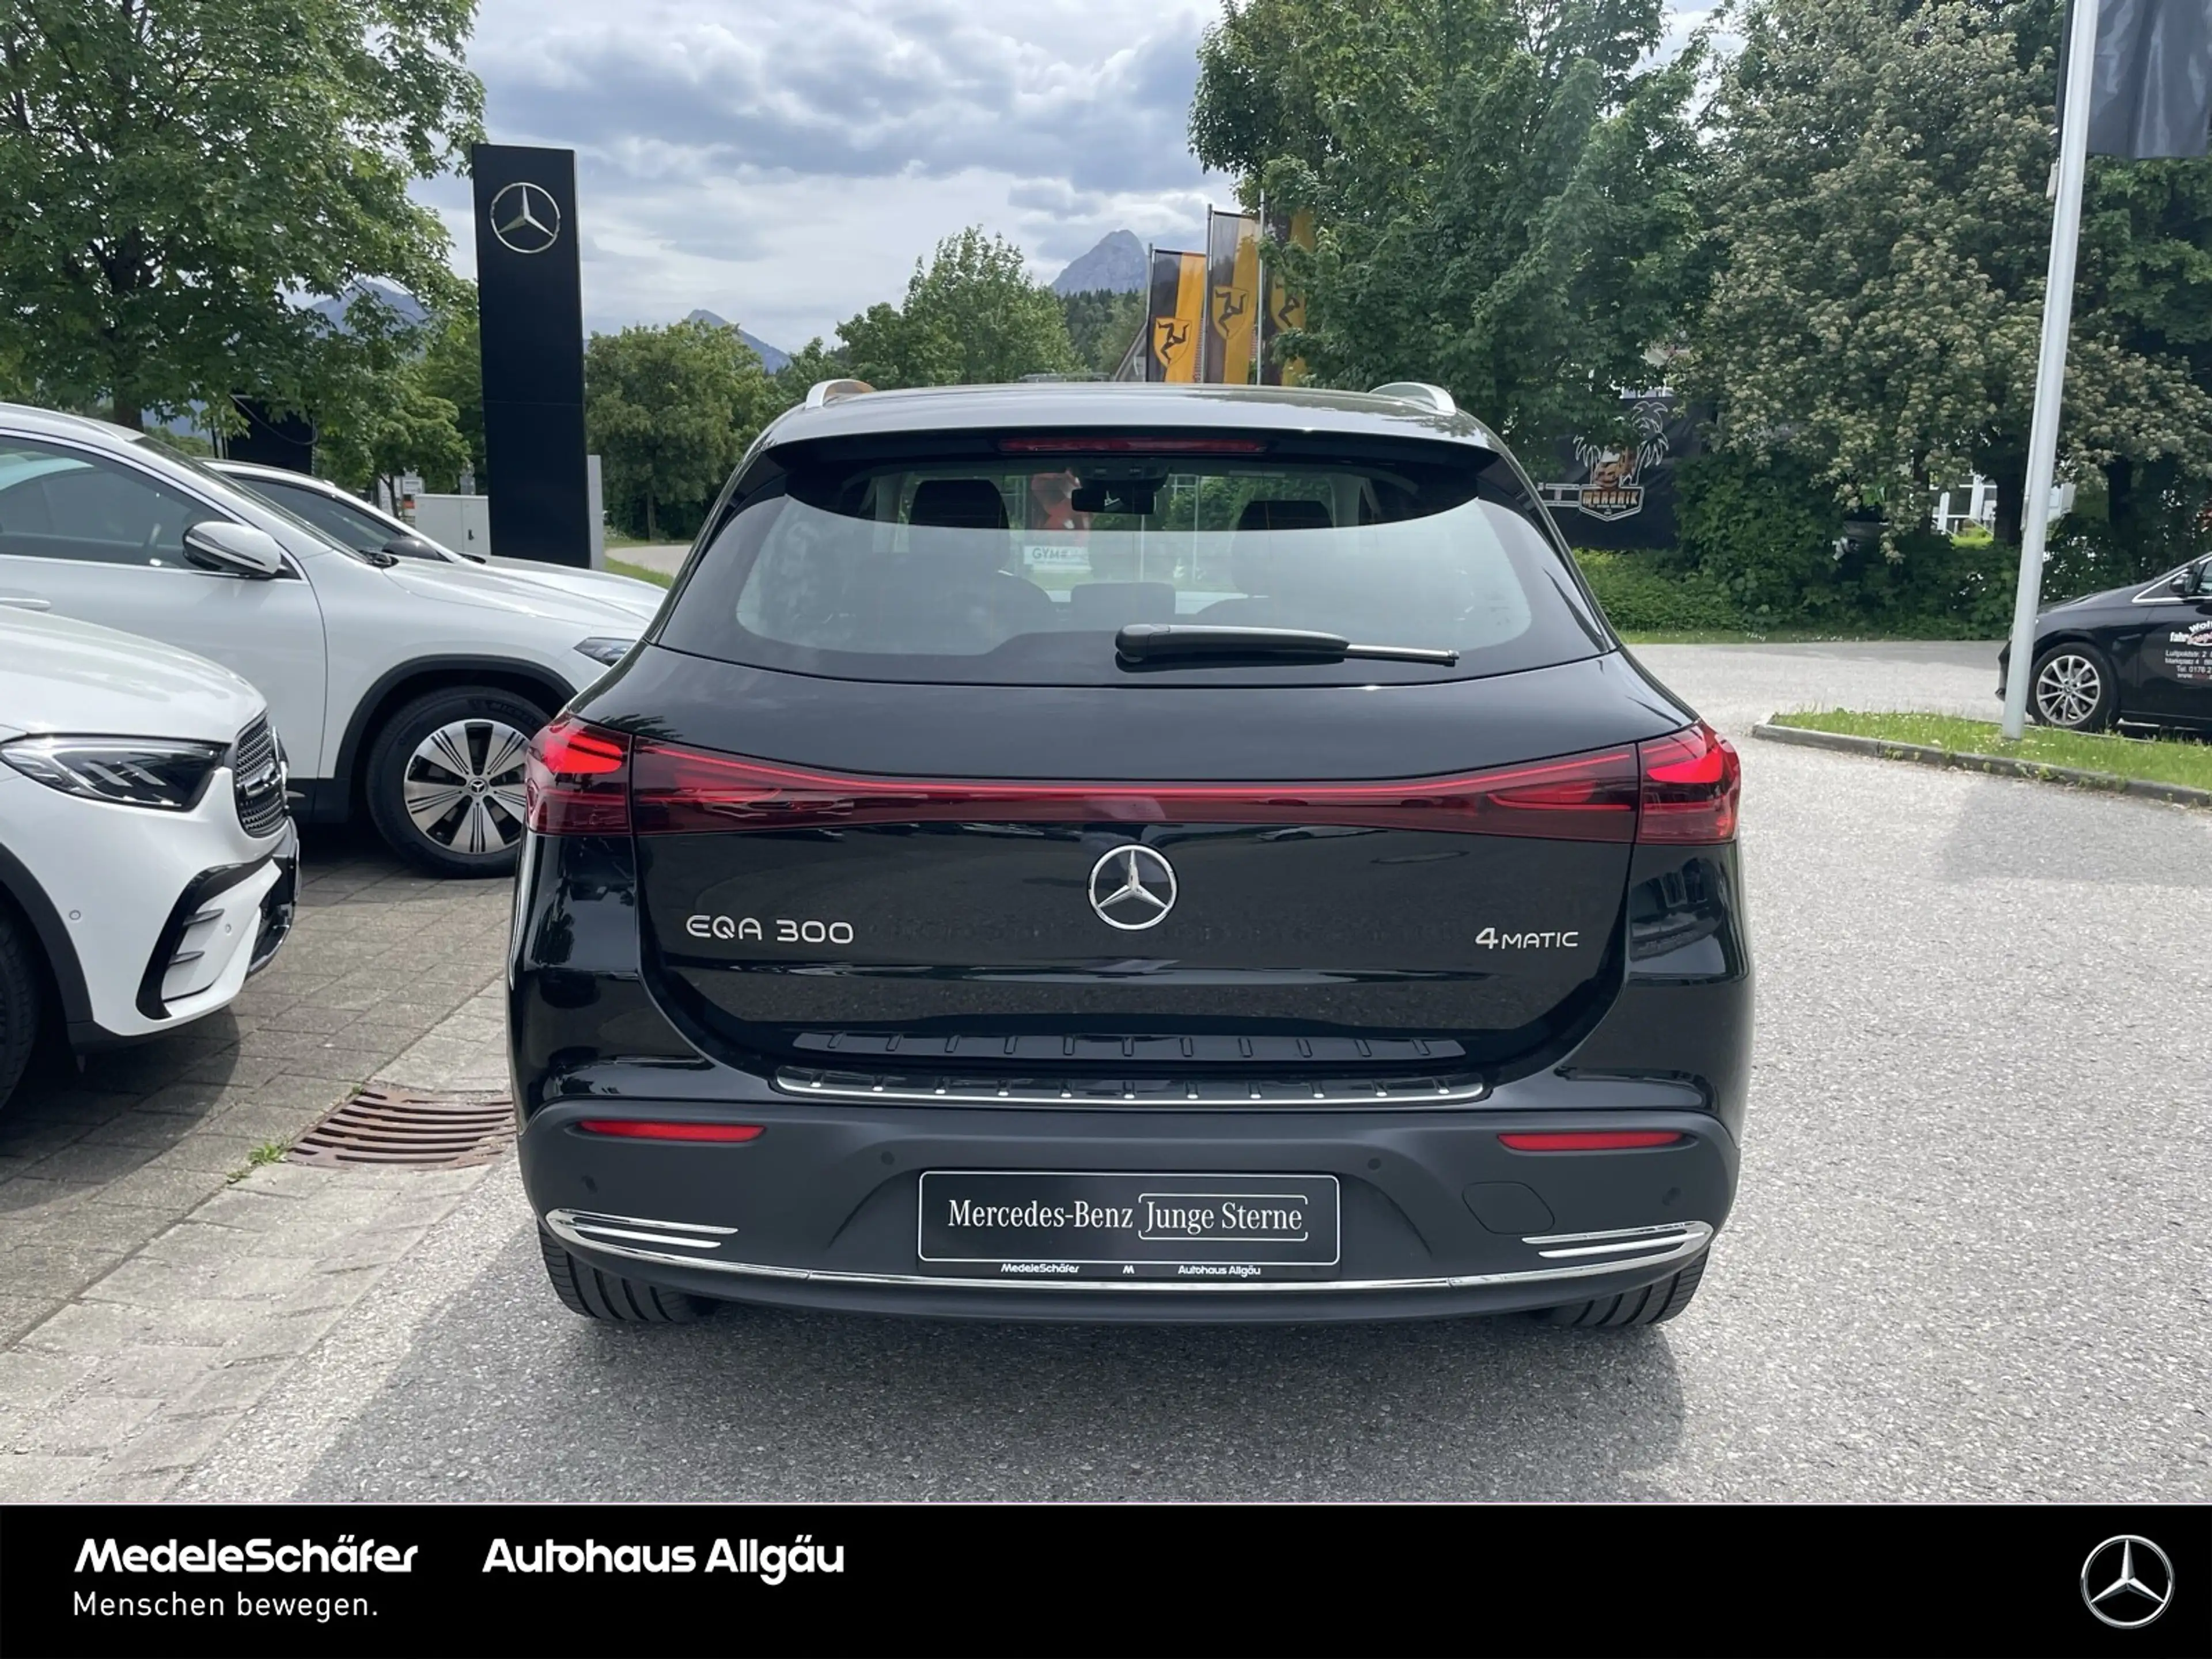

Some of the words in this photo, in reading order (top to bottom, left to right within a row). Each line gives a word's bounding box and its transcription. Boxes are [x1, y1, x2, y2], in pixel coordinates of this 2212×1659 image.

[686, 915, 763, 941] EQA
[776, 919, 854, 944] 300
[1475, 927, 1579, 949] 4MATIC
[948, 1199, 1134, 1228] Mercedes-Benz
[1145, 1201, 1215, 1235] Junge
[1222, 1202, 1302, 1230] Sterne
[1001, 1263, 1079, 1274] MedeleSchäfer
[1177, 1264, 1227, 1275] Autohaus
[1228, 1264, 1262, 1278] Allgäu
